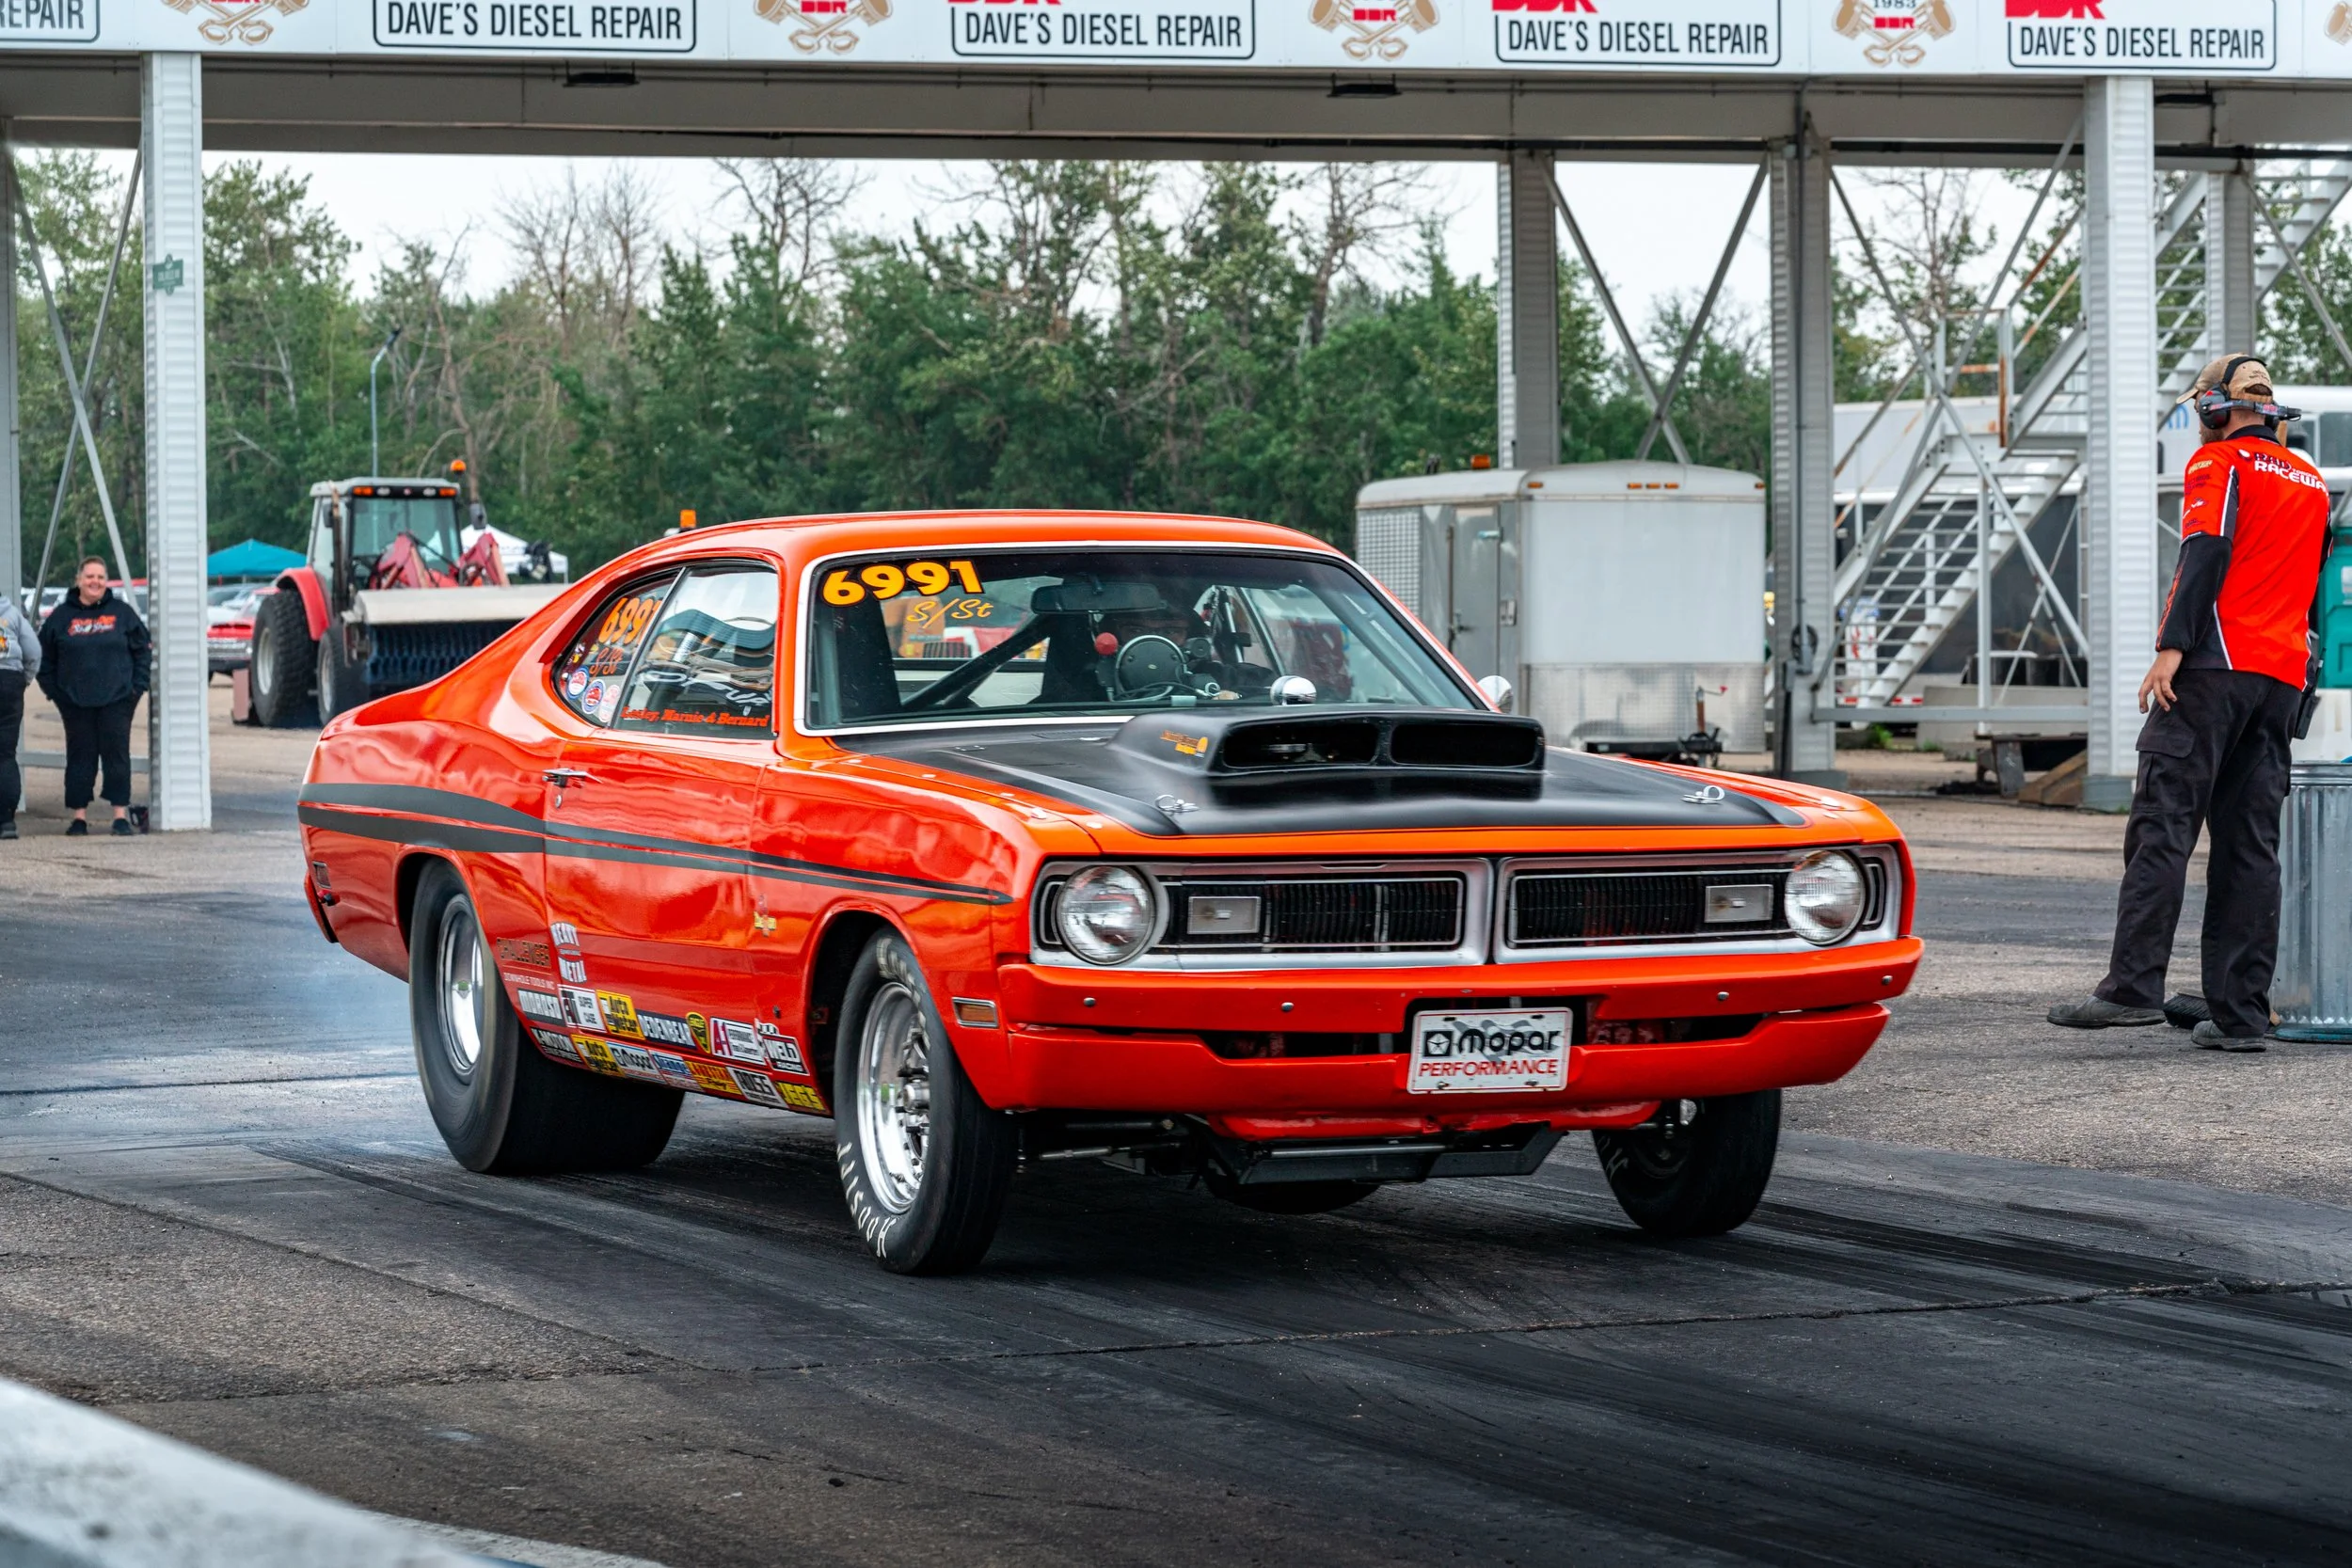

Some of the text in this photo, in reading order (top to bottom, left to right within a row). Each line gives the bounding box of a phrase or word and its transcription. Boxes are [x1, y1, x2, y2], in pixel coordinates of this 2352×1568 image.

[388, 2, 682, 40] DAVE'S DIESEL REPAIR
[965, 12, 1242, 47] DAVE'S DIESEL REPAIR
[1508, 20, 1769, 55] DAVE'S DIESEL REPAIR
[2020, 26, 2265, 59] DAVE'S DIESEL REPAIR
[2254, 460, 2328, 494] RACEWA
[821, 561, 985, 607] 6991
[717, 712, 770, 727] Bernard
[1418, 1058, 1559, 1077] PERFORMANCE
